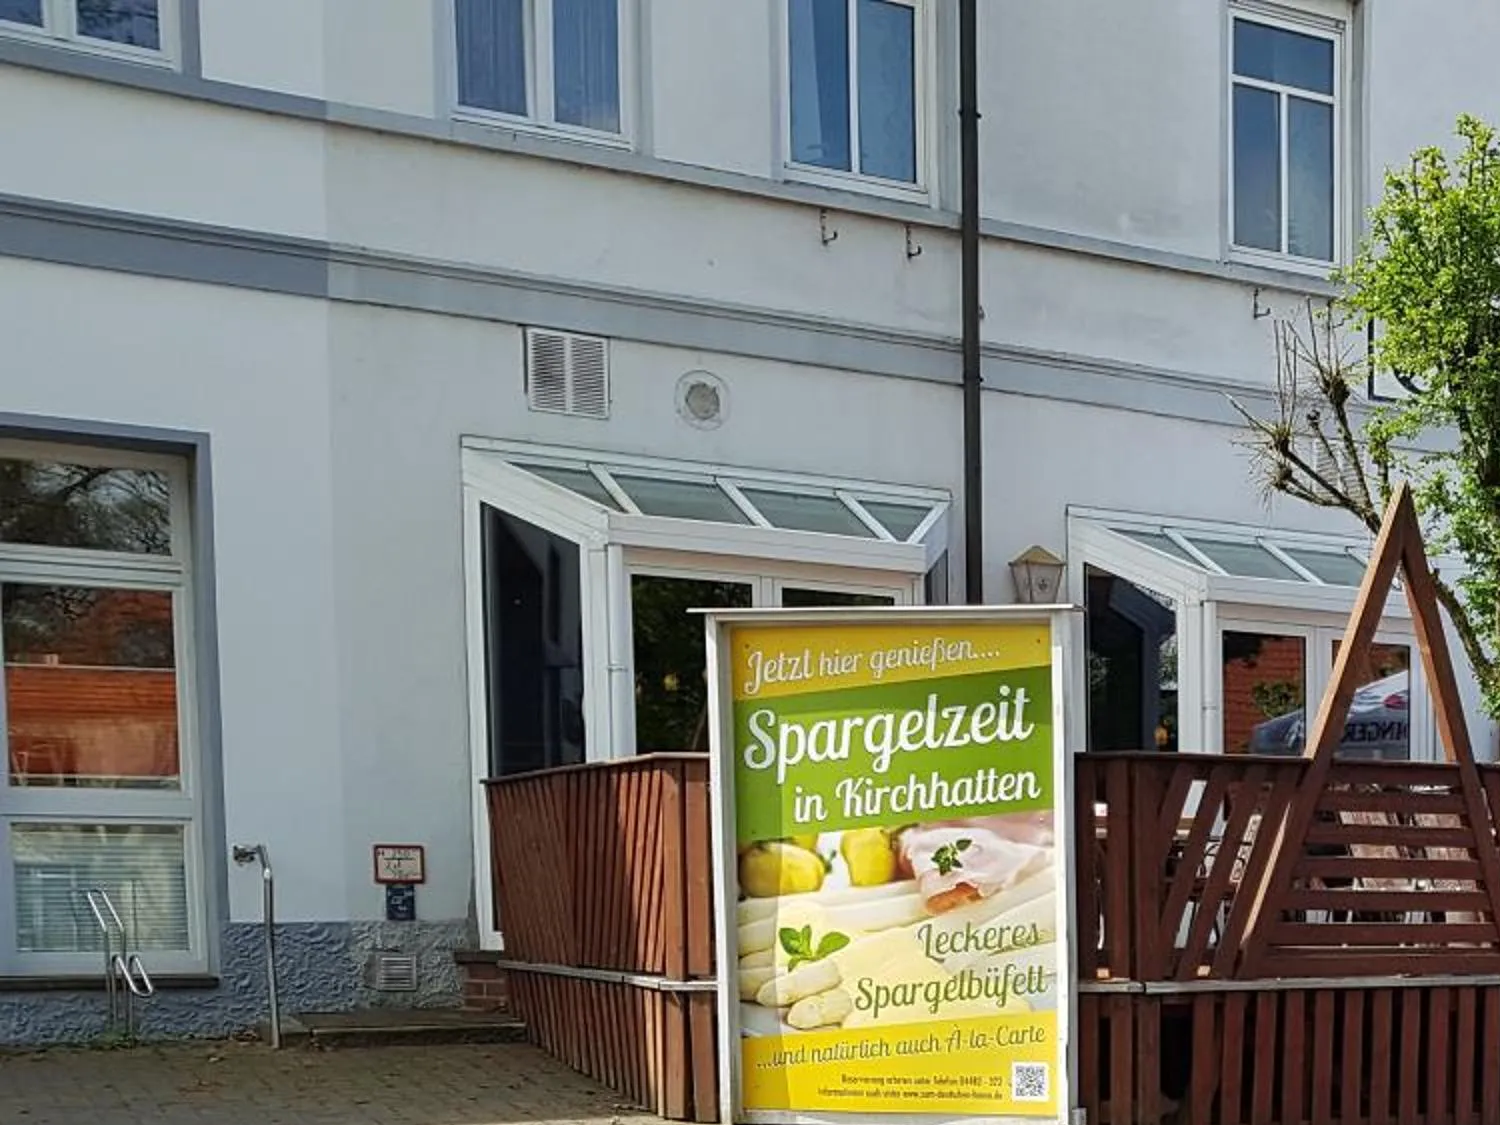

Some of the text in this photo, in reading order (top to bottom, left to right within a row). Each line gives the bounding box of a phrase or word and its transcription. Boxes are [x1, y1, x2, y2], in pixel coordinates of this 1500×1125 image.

[744, 649, 813, 695] Jetzt
[819, 649, 862, 677] hier
[744, 685, 1034, 784] Spargelzeit
[794, 770, 1040, 823] in Kirchhatten
[917, 921, 1040, 960] Leckeres
[855, 964, 1047, 1018] Spargelbüfett
[812, 1037, 891, 1063] natürlich
[896, 1034, 940, 1055] auch
